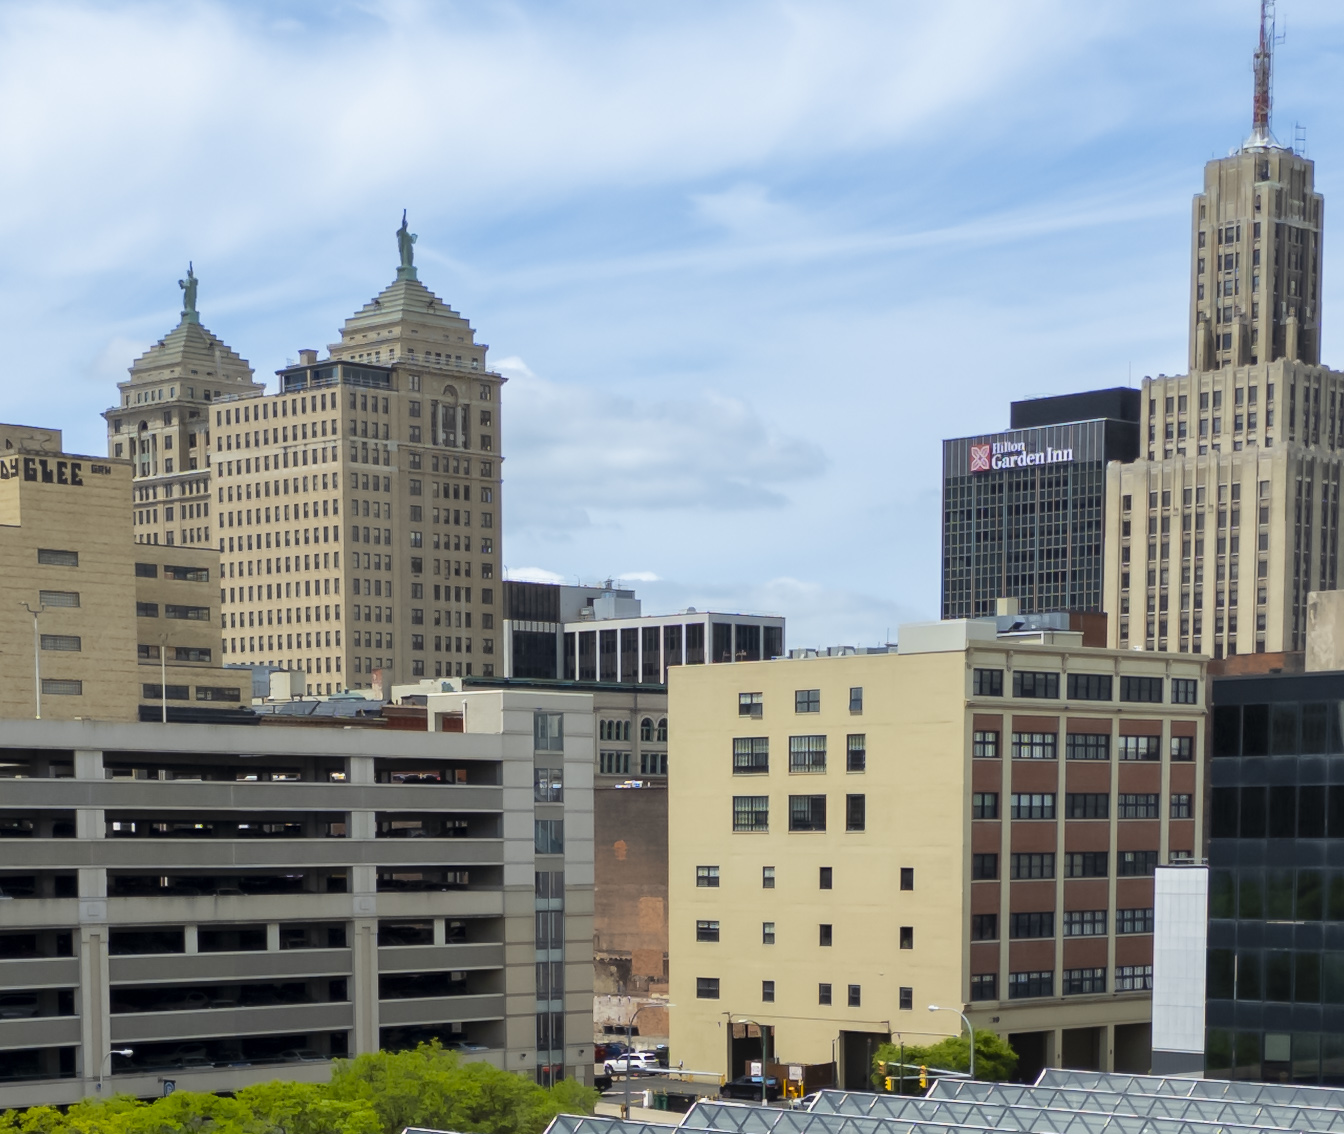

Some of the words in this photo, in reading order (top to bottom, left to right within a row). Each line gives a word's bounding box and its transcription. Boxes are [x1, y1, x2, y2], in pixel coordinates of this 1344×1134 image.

[992, 442, 1025, 454] Hilton
[991, 451, 1045, 469] Garden
[1046, 446, 1073, 463] Inn
